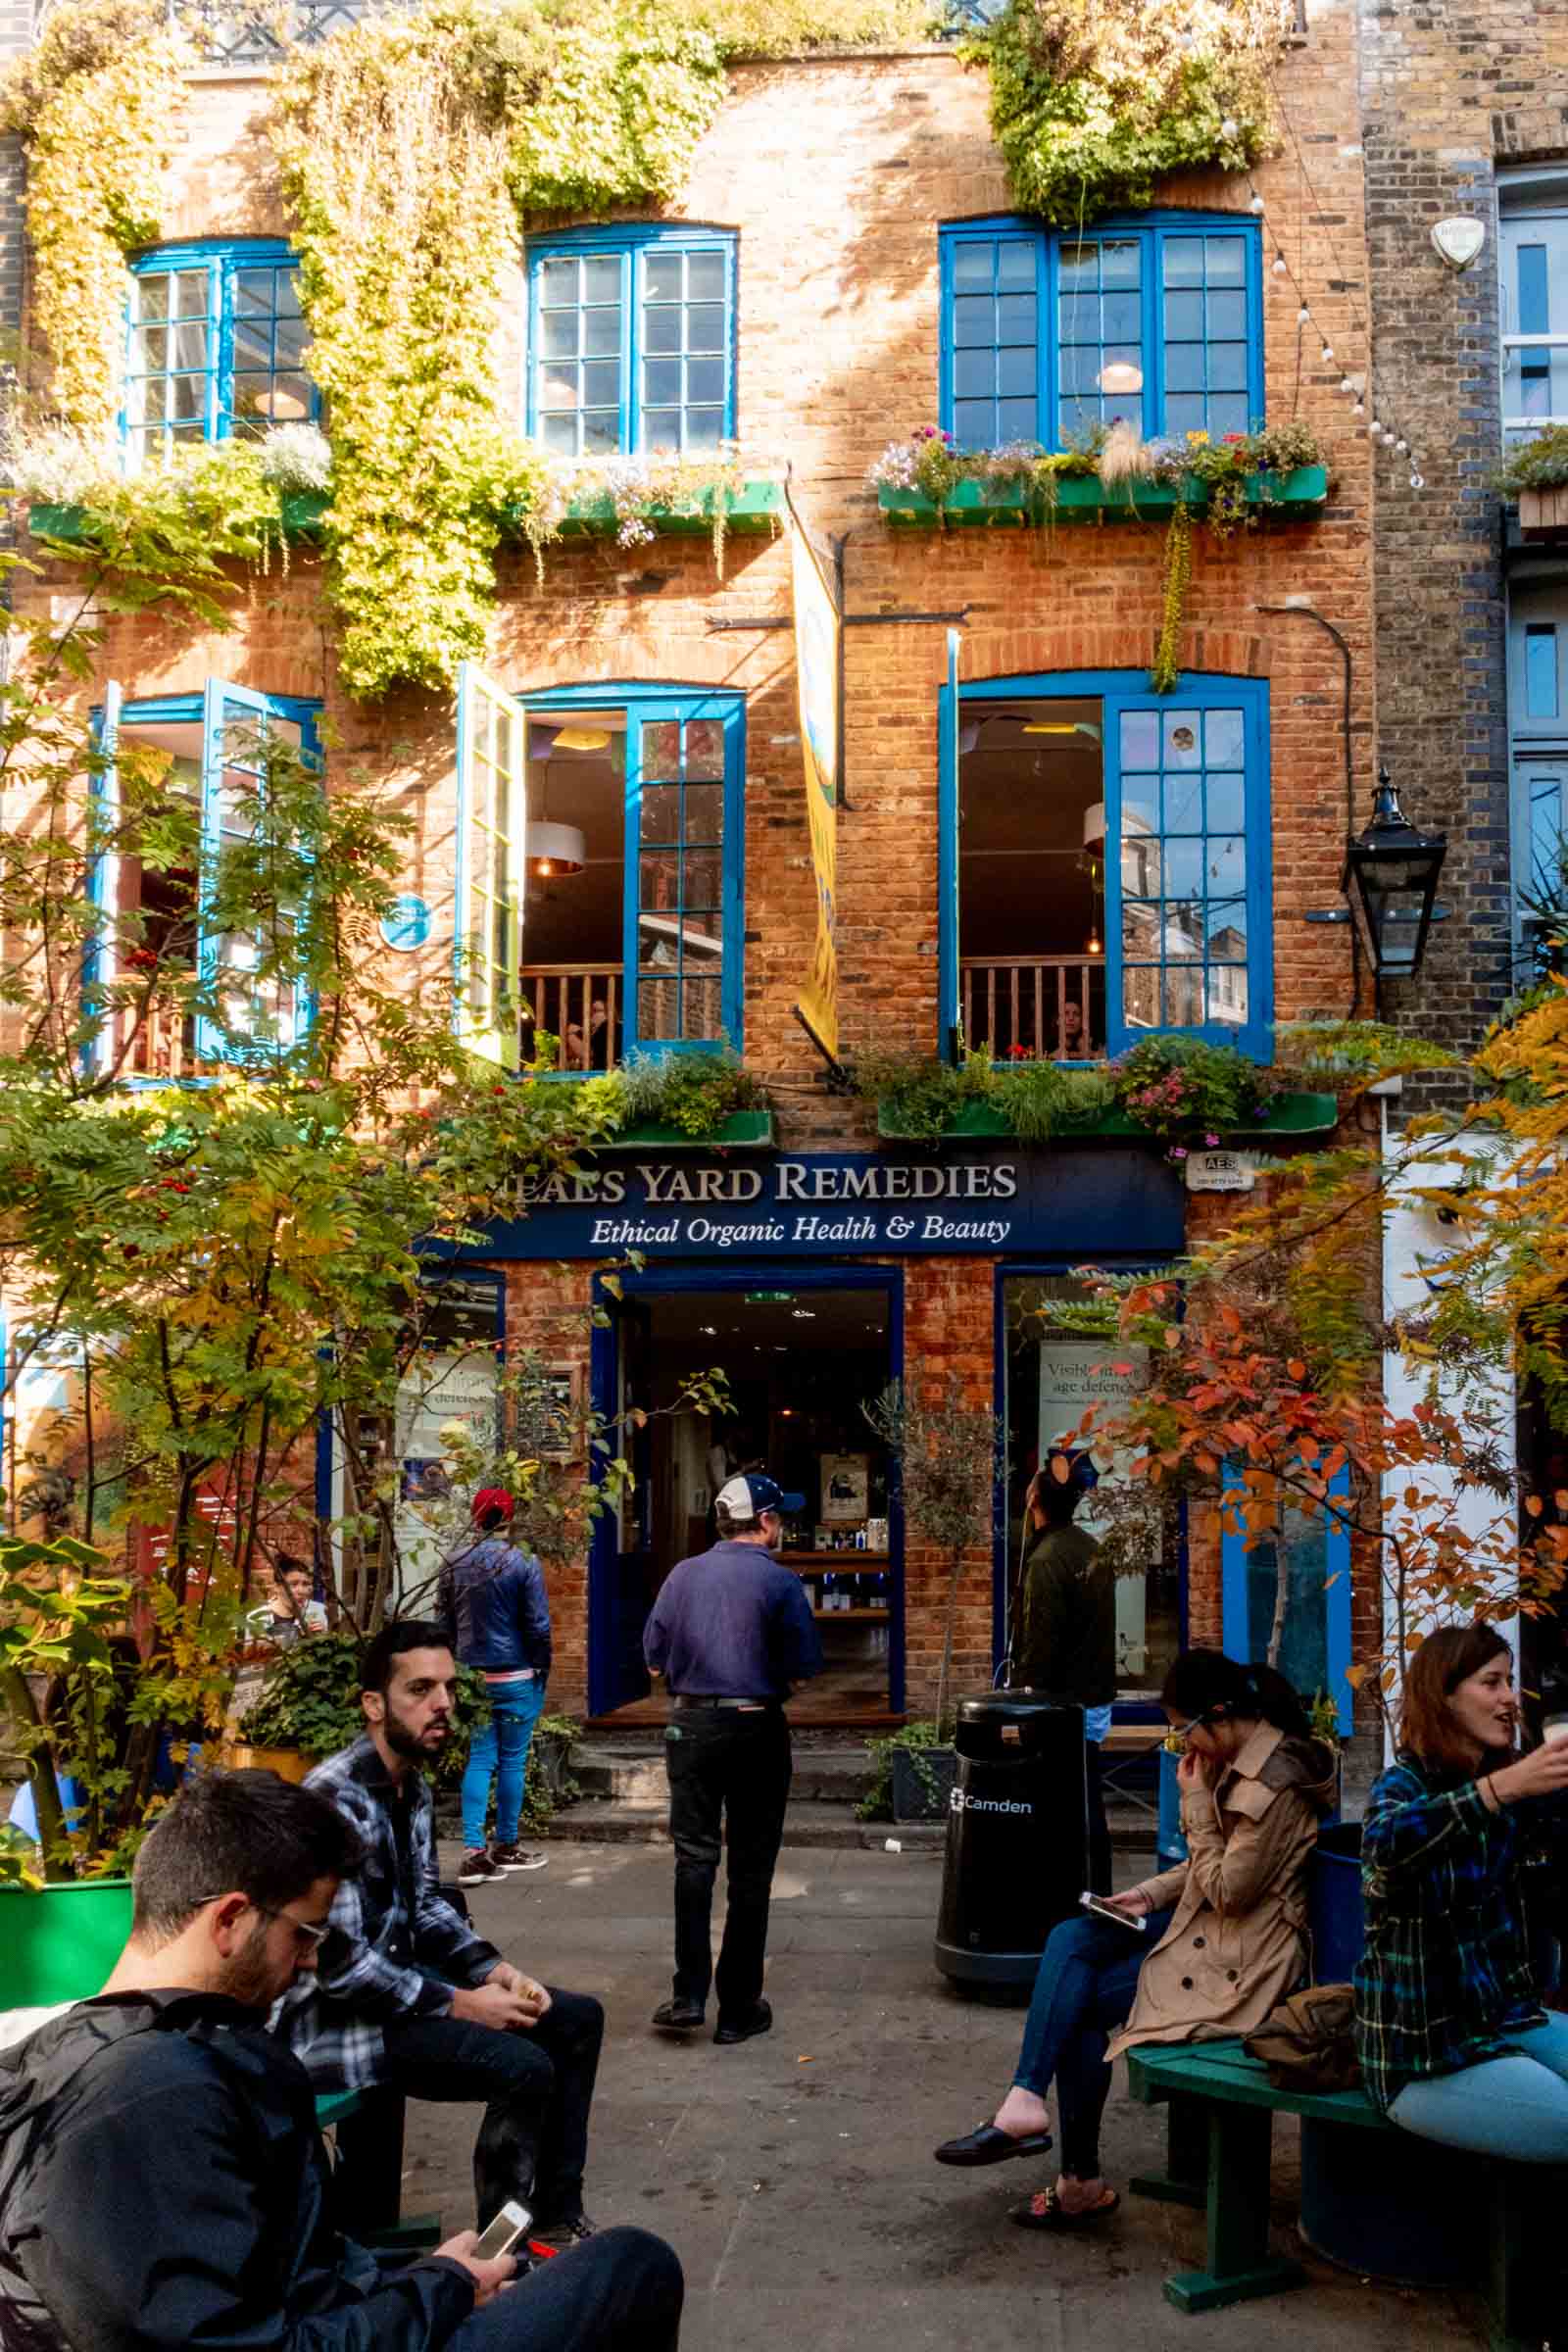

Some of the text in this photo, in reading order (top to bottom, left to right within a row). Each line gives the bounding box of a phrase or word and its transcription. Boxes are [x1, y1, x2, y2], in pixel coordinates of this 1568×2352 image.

[636, 1163, 762, 1201] YARD
[774, 1162, 1017, 1200] REMEDIES
[590, 1215, 1011, 1247] Ethical Organic Health & Beauty
[964, 1794, 1032, 1814] Camden
